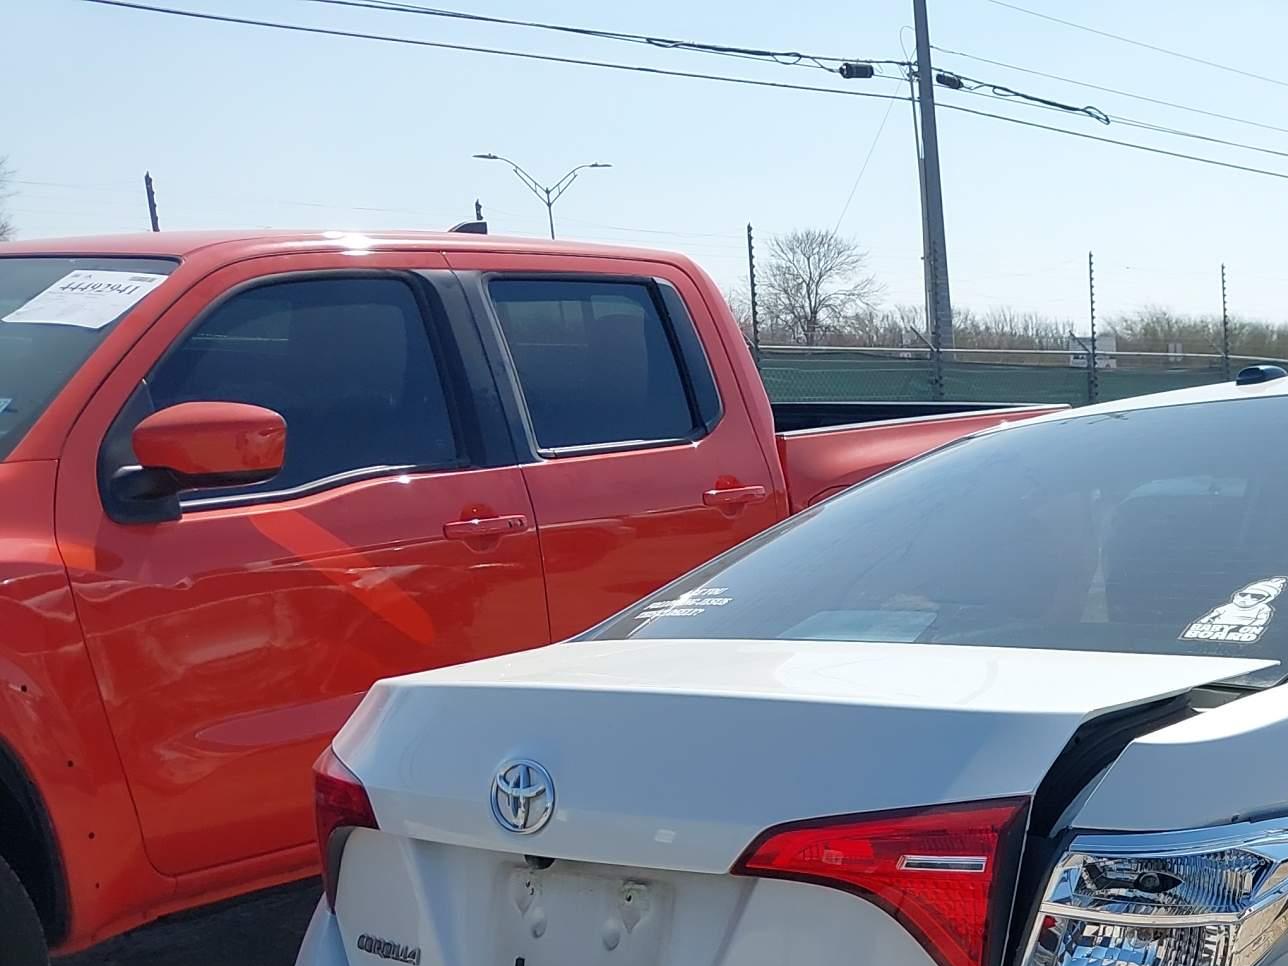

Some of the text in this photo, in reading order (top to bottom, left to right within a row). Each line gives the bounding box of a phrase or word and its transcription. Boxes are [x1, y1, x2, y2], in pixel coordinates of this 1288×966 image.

[60, 281, 140, 295] 44492941
[1190, 624, 1264, 634] BABY ON
[1184, 632, 1257, 641] BOARD
[357, 934, 421, 966] COROLLA
